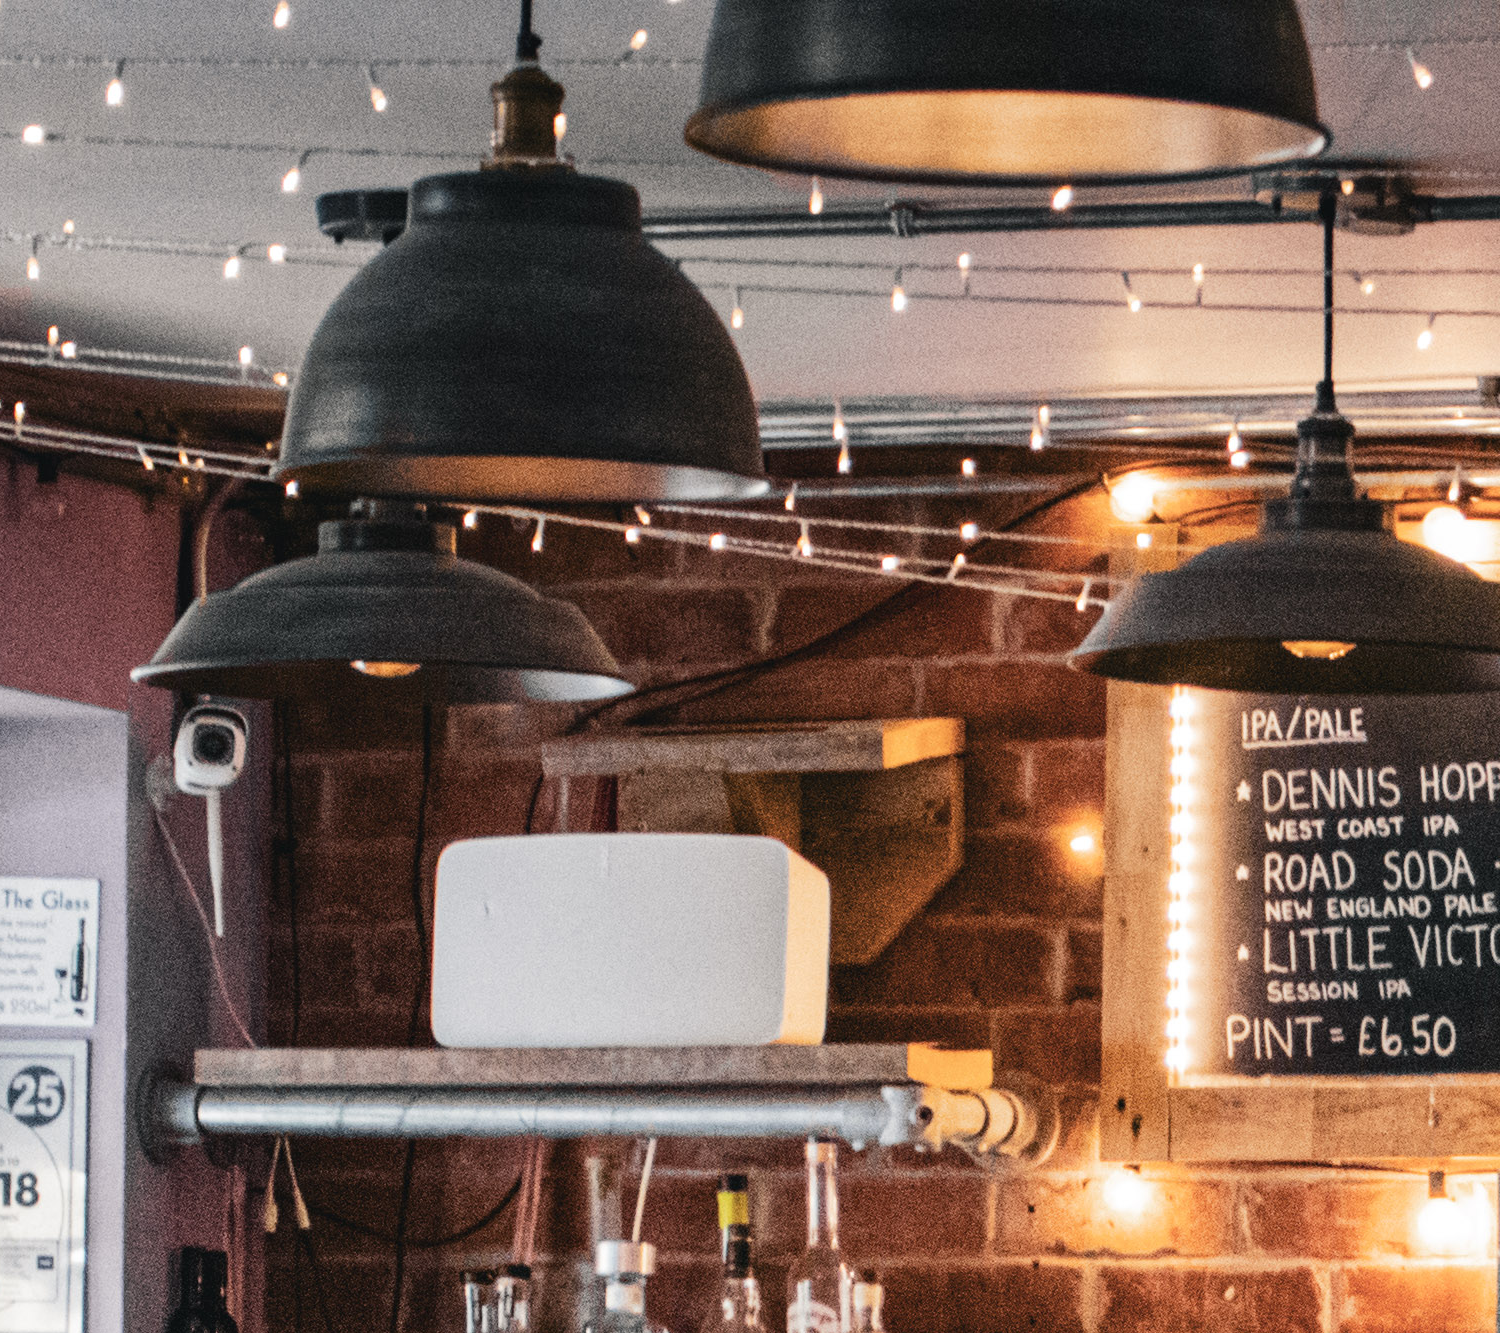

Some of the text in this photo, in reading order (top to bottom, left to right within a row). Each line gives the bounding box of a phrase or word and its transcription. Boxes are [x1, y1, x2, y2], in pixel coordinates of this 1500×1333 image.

[1242, 706, 1365, 744] IPA/PALE
[1262, 766, 1401, 811] DENNIS
[1265, 816, 1460, 842] WEST COAST IPA
[1264, 848, 1475, 893] ROAD SODA
[3, 889, 33, 909] The
[42, 889, 90, 910] Glass
[1264, 892, 1497, 922] NEW ENGLAND PALE
[1264, 926, 1393, 974] LITTLE
[1267, 978, 1412, 1003] SESSION IPA
[1358, 1015, 1457, 1058] £6.50
[11, 1072, 60, 1120] 25
